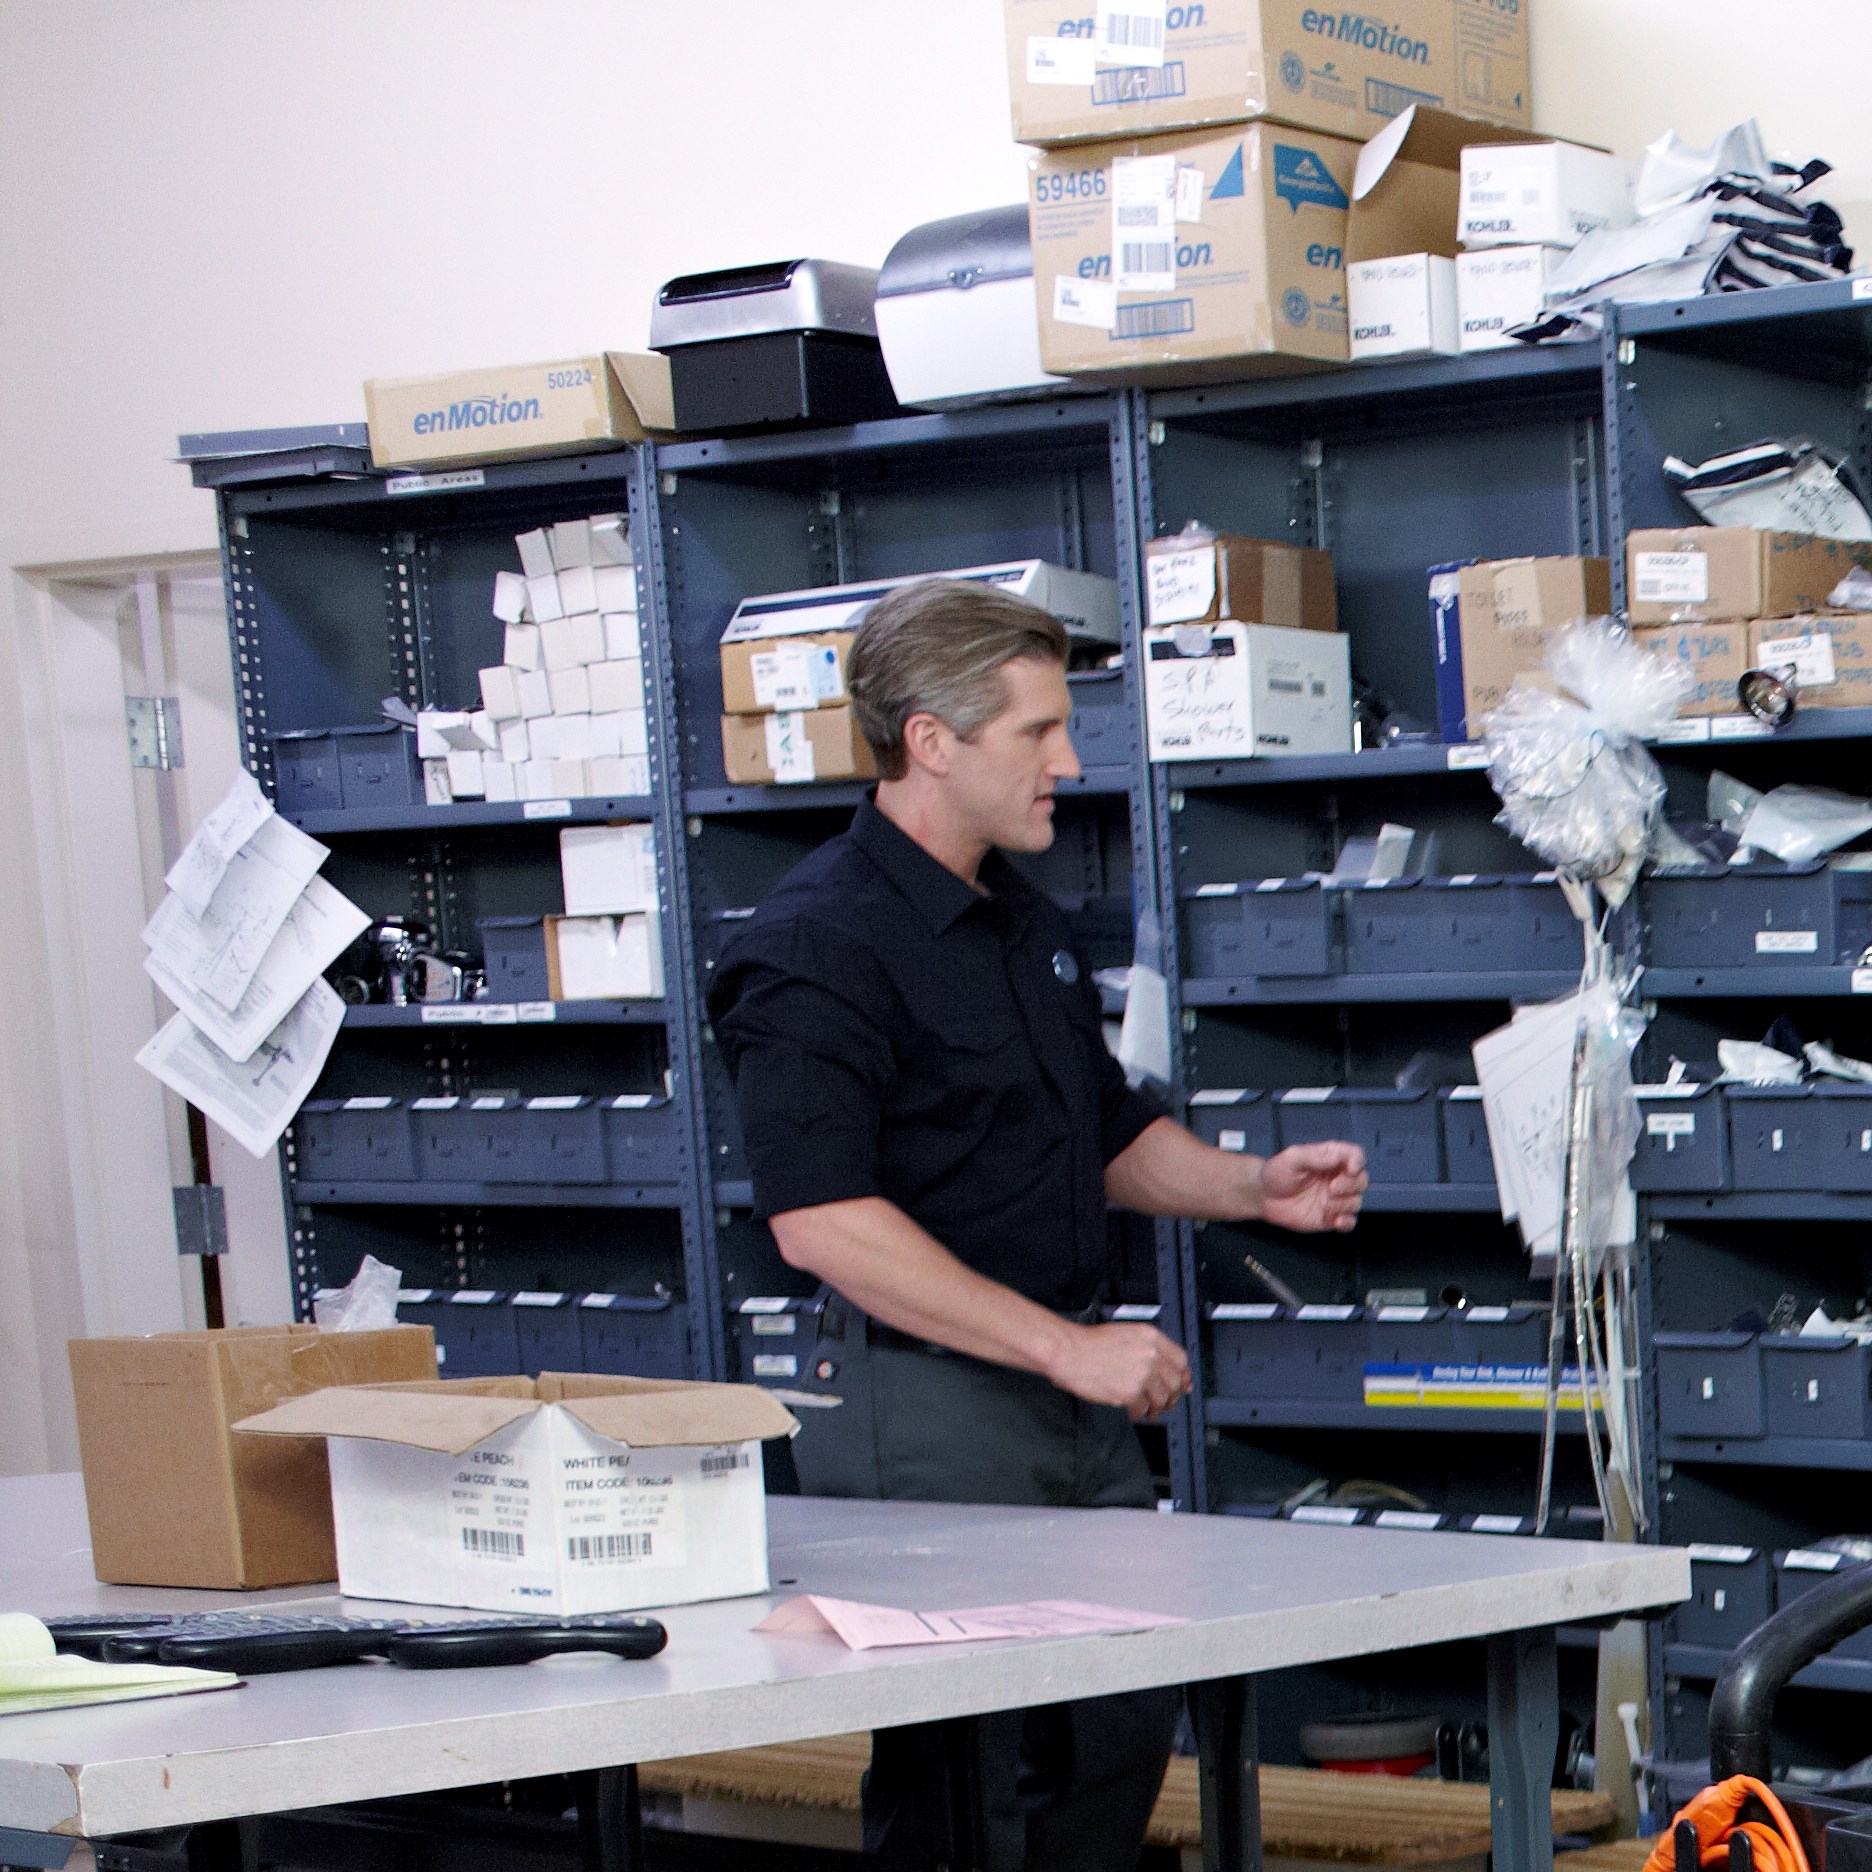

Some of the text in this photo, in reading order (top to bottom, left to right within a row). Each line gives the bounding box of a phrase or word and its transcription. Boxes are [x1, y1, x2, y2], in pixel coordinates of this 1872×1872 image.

[1301, 7, 1430, 65] enMotion
[1035, 169, 1107, 203] 59466
[546, 367, 592, 390] 50224
[413, 393, 540, 435] enMotion
[563, 1457, 606, 1470] WHITE
[565, 1478, 594, 1492] ITEM
